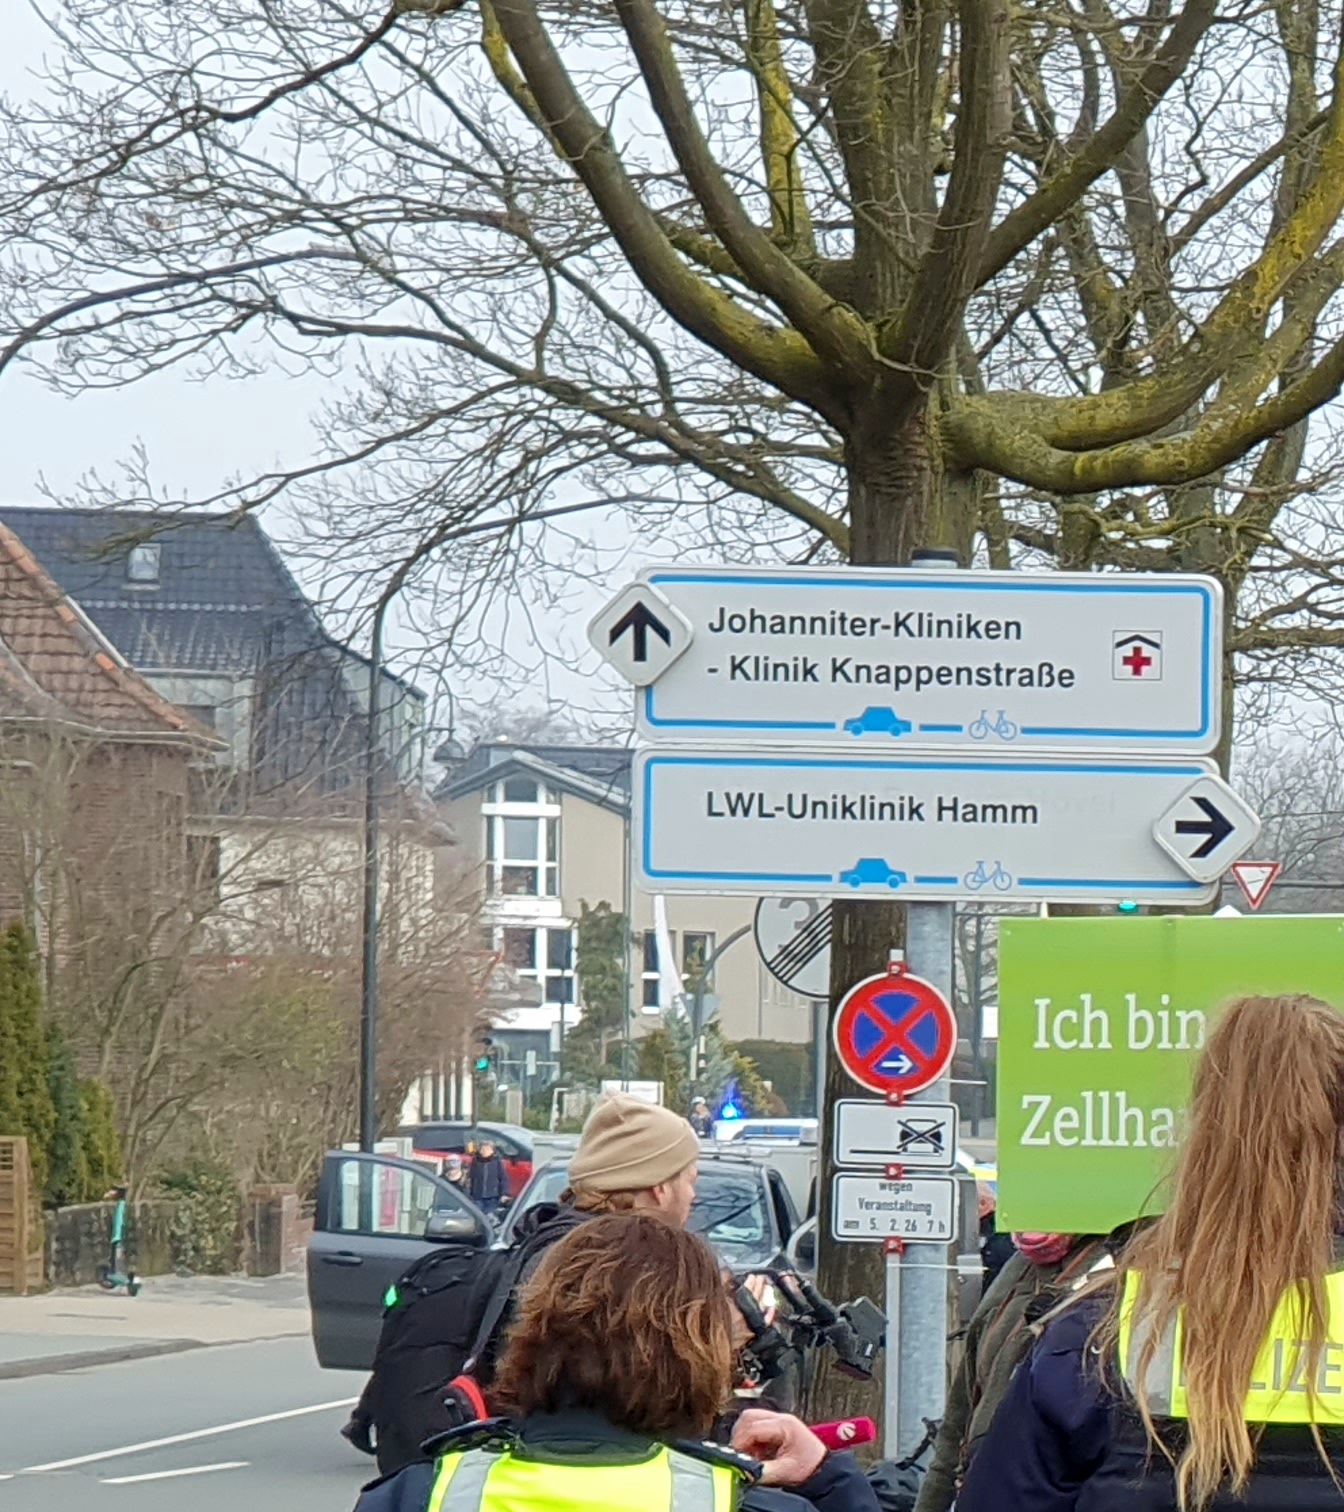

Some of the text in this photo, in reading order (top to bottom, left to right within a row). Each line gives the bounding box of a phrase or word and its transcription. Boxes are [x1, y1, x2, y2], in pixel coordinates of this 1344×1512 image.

[708, 606, 1022, 642] Johanniter-Kliniken
[728, 654, 820, 684] Klinik
[831, 657, 1075, 692] Knappenstraße
[705, 790, 925, 824] LWL-Uniklinik
[936, 797, 1038, 825] Hamm
[1033, 993, 1207, 1050] Ich bin
[879, 1182, 913, 1194] wegen
[858, 1198, 932, 1215] Veranstaltung
